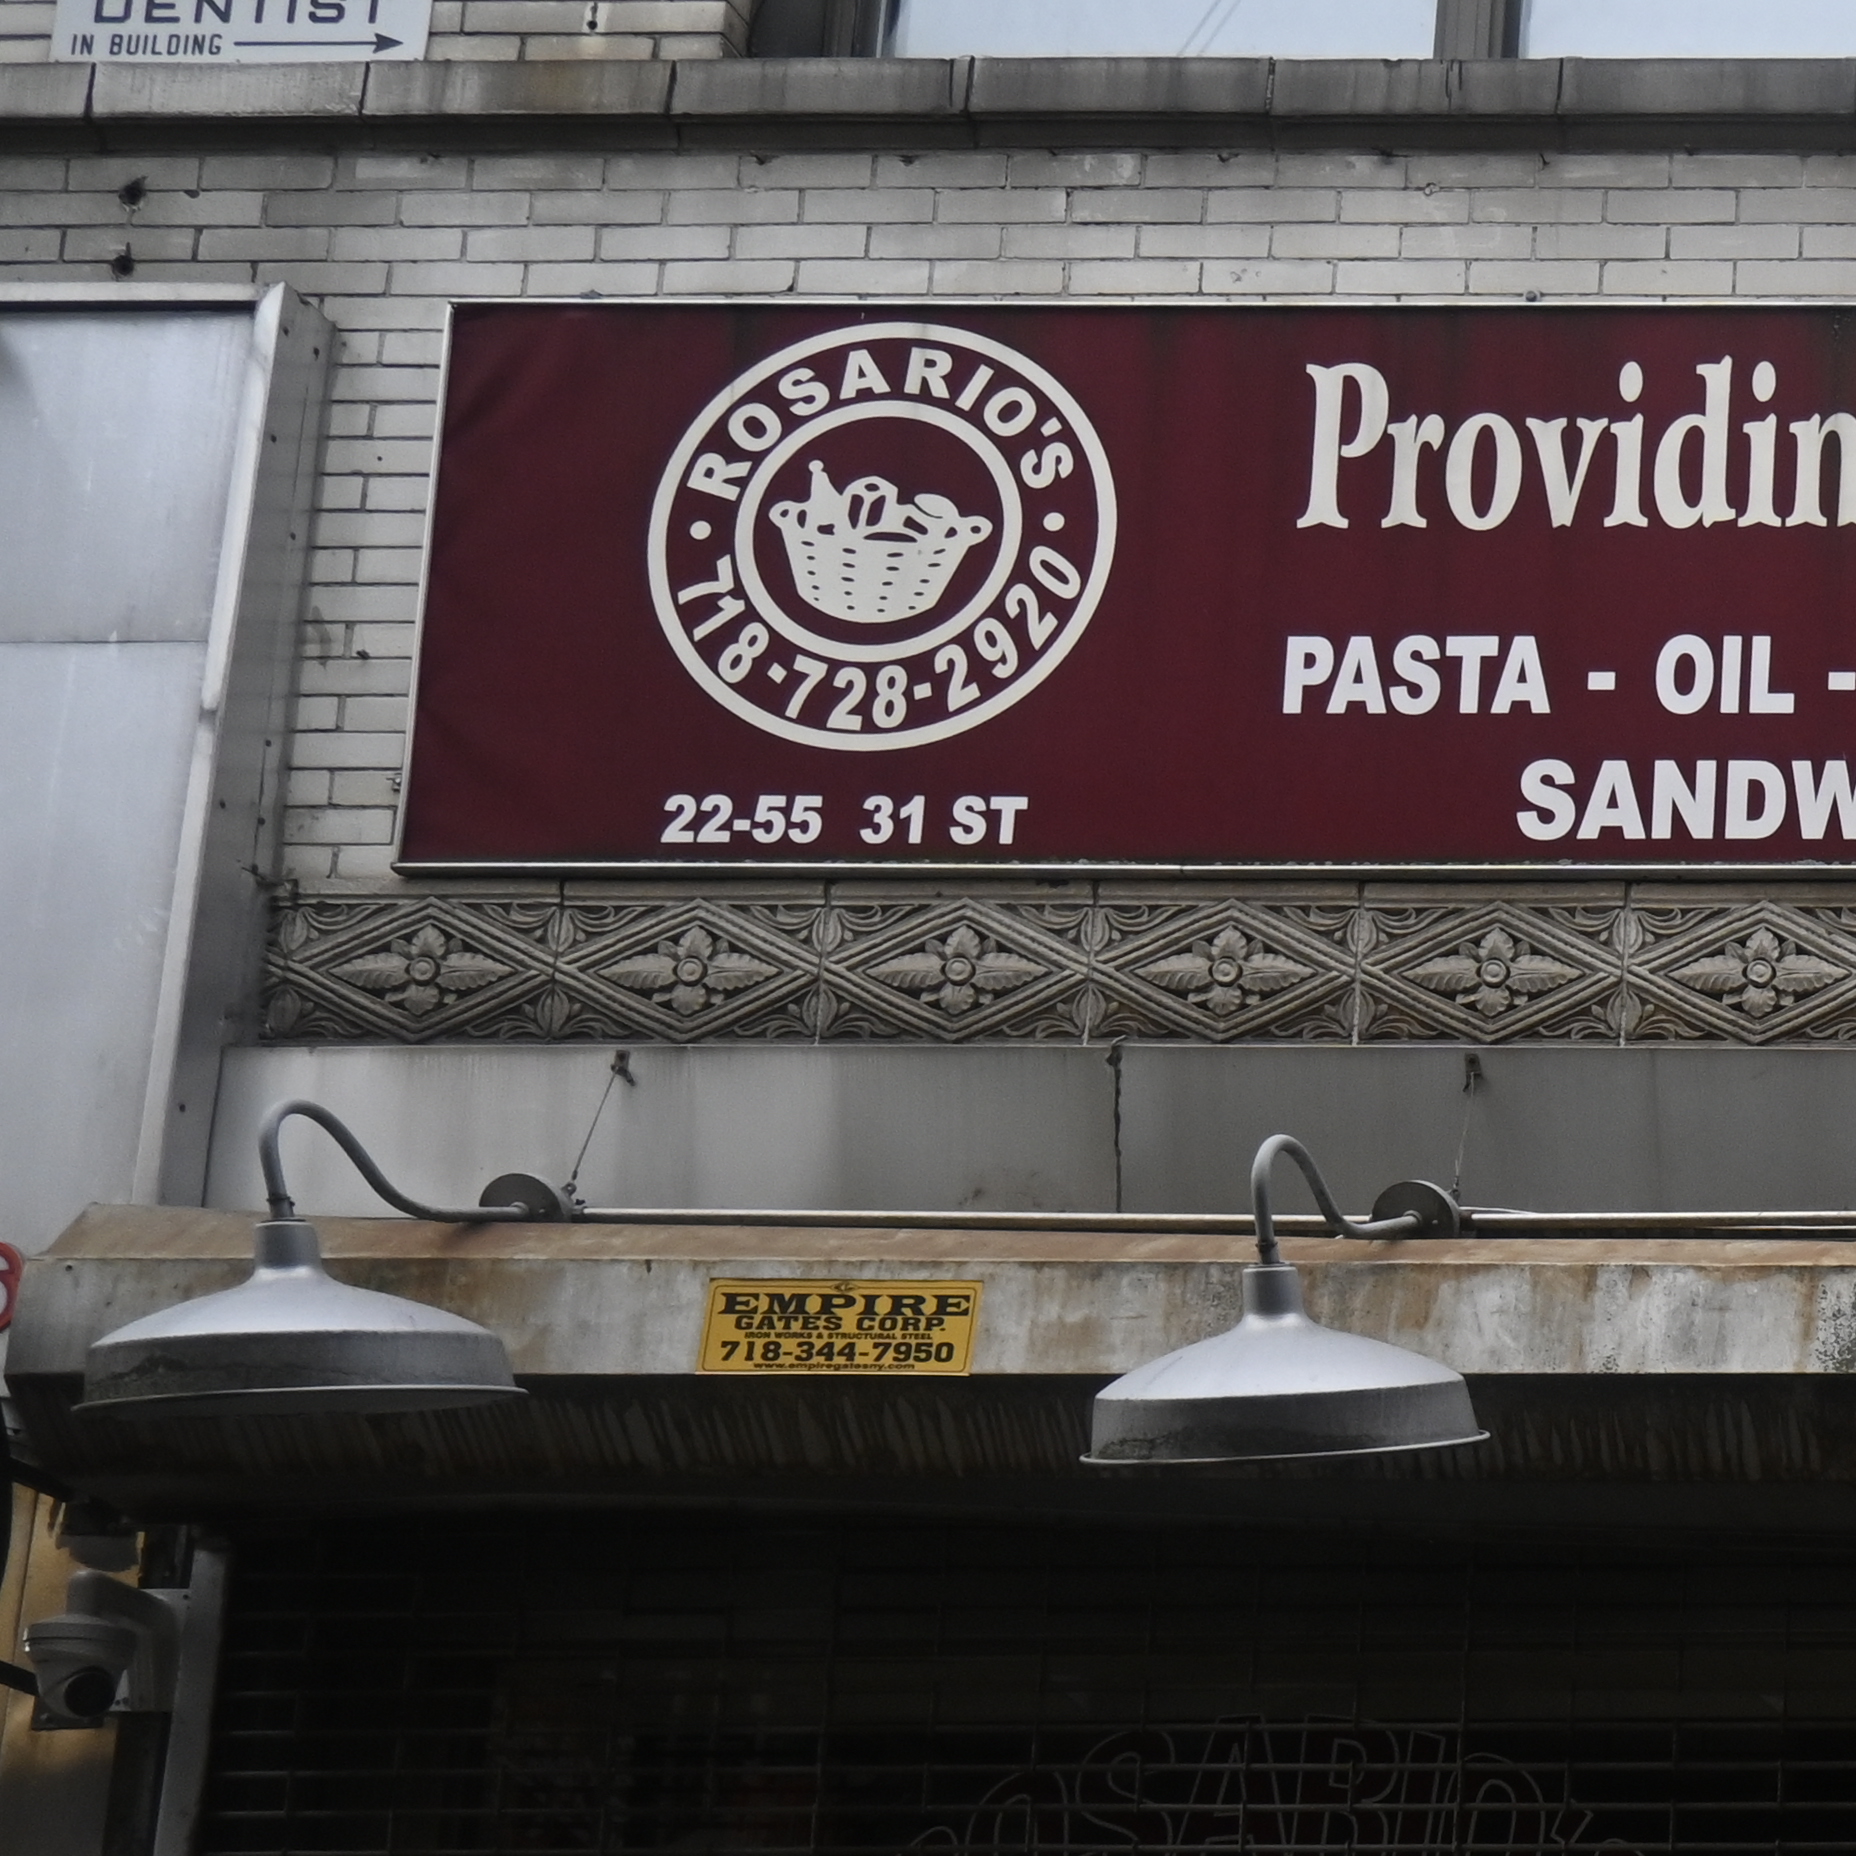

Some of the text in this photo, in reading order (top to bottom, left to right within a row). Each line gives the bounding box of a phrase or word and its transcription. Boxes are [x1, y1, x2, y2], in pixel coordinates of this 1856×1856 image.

[71, 34, 223, 56] IN BUILDING
[686, 346, 1075, 502] ROSARIO'S
[677, 545, 1082, 731] 718-728-2920
[1283, 635, 1550, 715] PASTA
[1656, 634, 1794, 714] OIL
[661, 795, 1028, 844] 22-55 31 ST
[717, 1292, 971, 1317] EMPIRE
[734, 1316, 946, 1332] GATES CORP.
[745, 1332, 771, 1340] IRON
[775, 1332, 813, 1340] WORKS
[827, 1332, 898, 1340] STRUCTURAL
[901, 1333, 933, 1341] STEEL
[721, 1340, 954, 1363] 718-344-7950
[754, 1362, 916, 1372] www.empiregatesny.com
